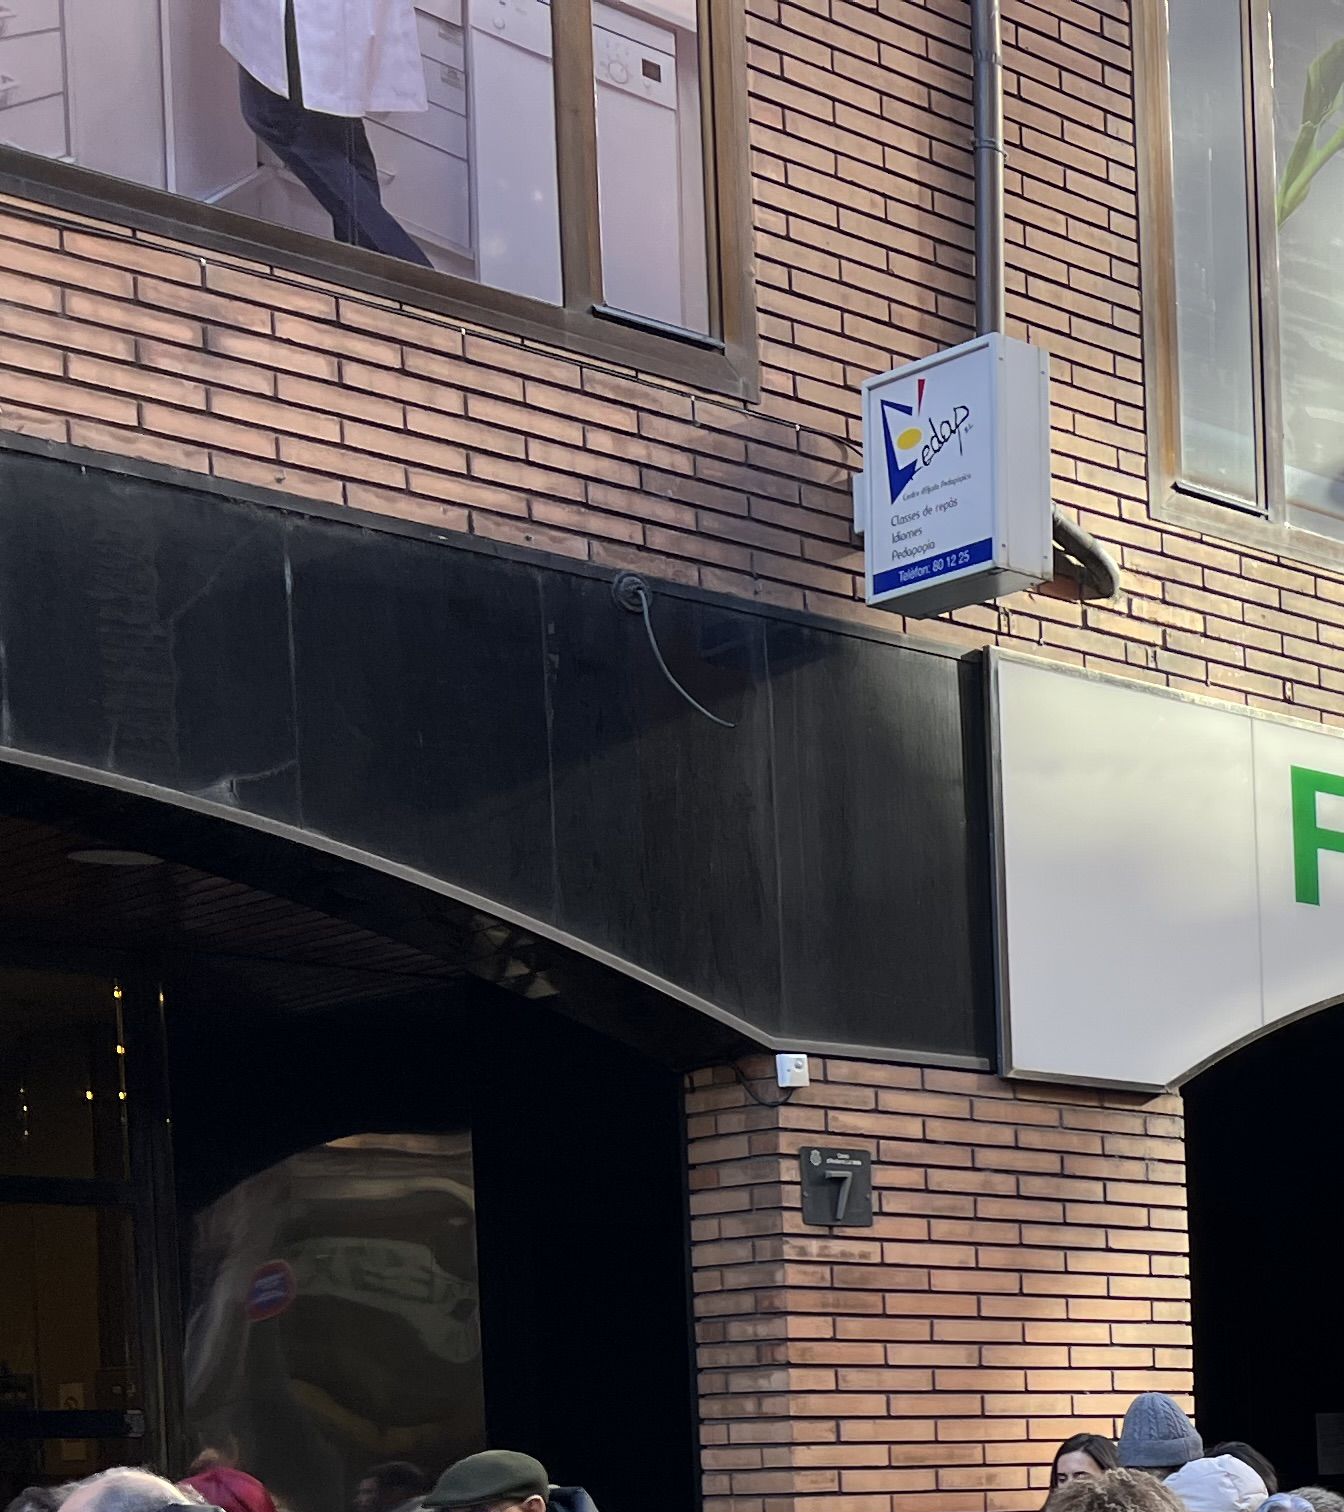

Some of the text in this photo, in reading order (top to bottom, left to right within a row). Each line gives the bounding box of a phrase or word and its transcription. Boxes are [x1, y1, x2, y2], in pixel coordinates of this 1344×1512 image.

[891, 510, 920, 527] Classes
[922, 504, 933, 517] de
[891, 527, 922, 544] Idiomes
[932, 557, 944, 573] 80
[946, 553, 957, 567] 12
[958, 549, 970, 563] 25
[824, 1170, 852, 1220] 7
